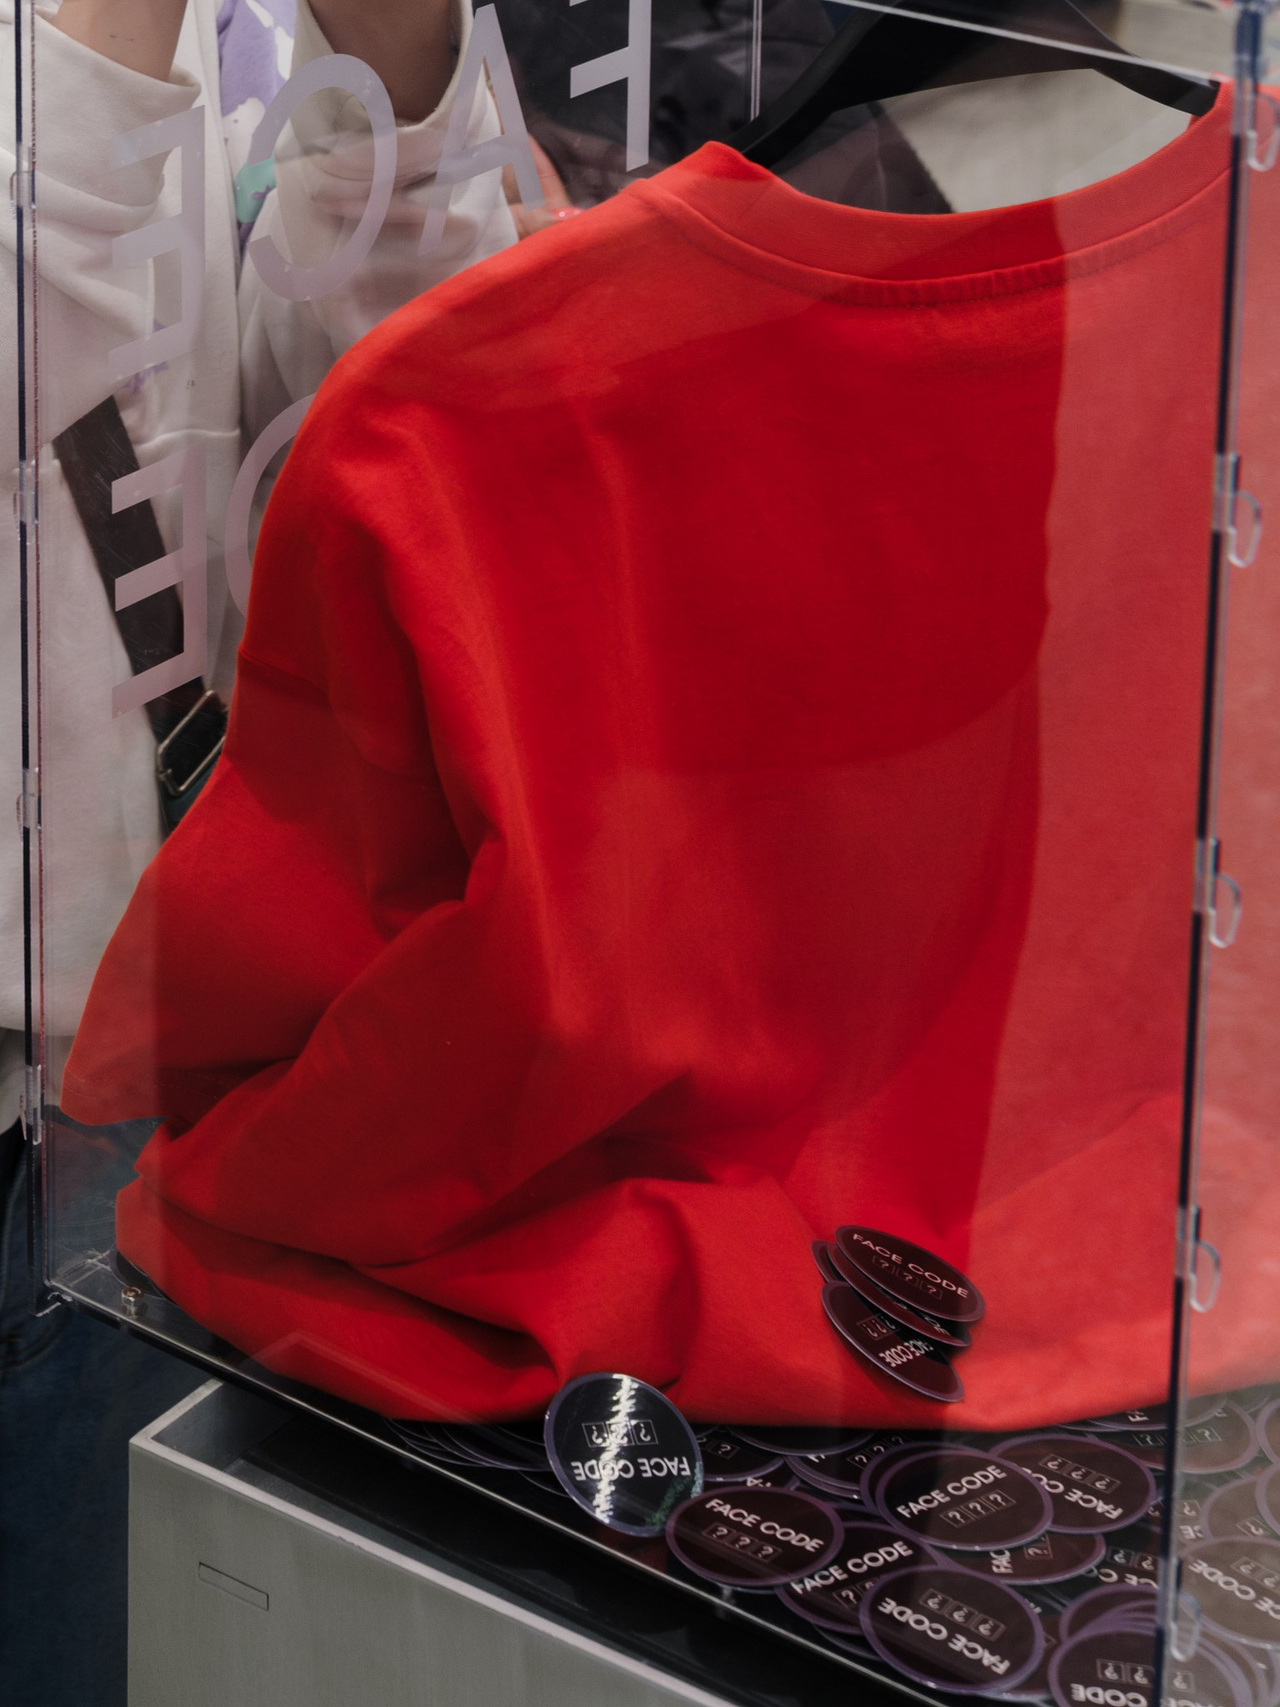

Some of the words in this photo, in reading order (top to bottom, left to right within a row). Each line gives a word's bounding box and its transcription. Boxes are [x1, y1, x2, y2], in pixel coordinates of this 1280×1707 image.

[852, 1233, 904, 1265] FACE
[907, 1262, 969, 1299] CODE
[878, 1345, 914, 1368] CODE
[570, 1459, 635, 1481] CODE
[637, 1456, 691, 1478] FACE
[896, 1488, 951, 1519] FACE
[946, 1465, 1008, 1496] CODE
[1063, 1488, 1124, 1520] FACE
[704, 1498, 761, 1528] FACE
[759, 1521, 825, 1553] CODE
[789, 1565, 848, 1595] FACE
[846, 1540, 914, 1573] CODE
[1187, 1559, 1257, 1602] CODE
[877, 1597, 948, 1641] CODE
[947, 1633, 1011, 1676] FACE
[1069, 1682, 1149, 1707] CODE
